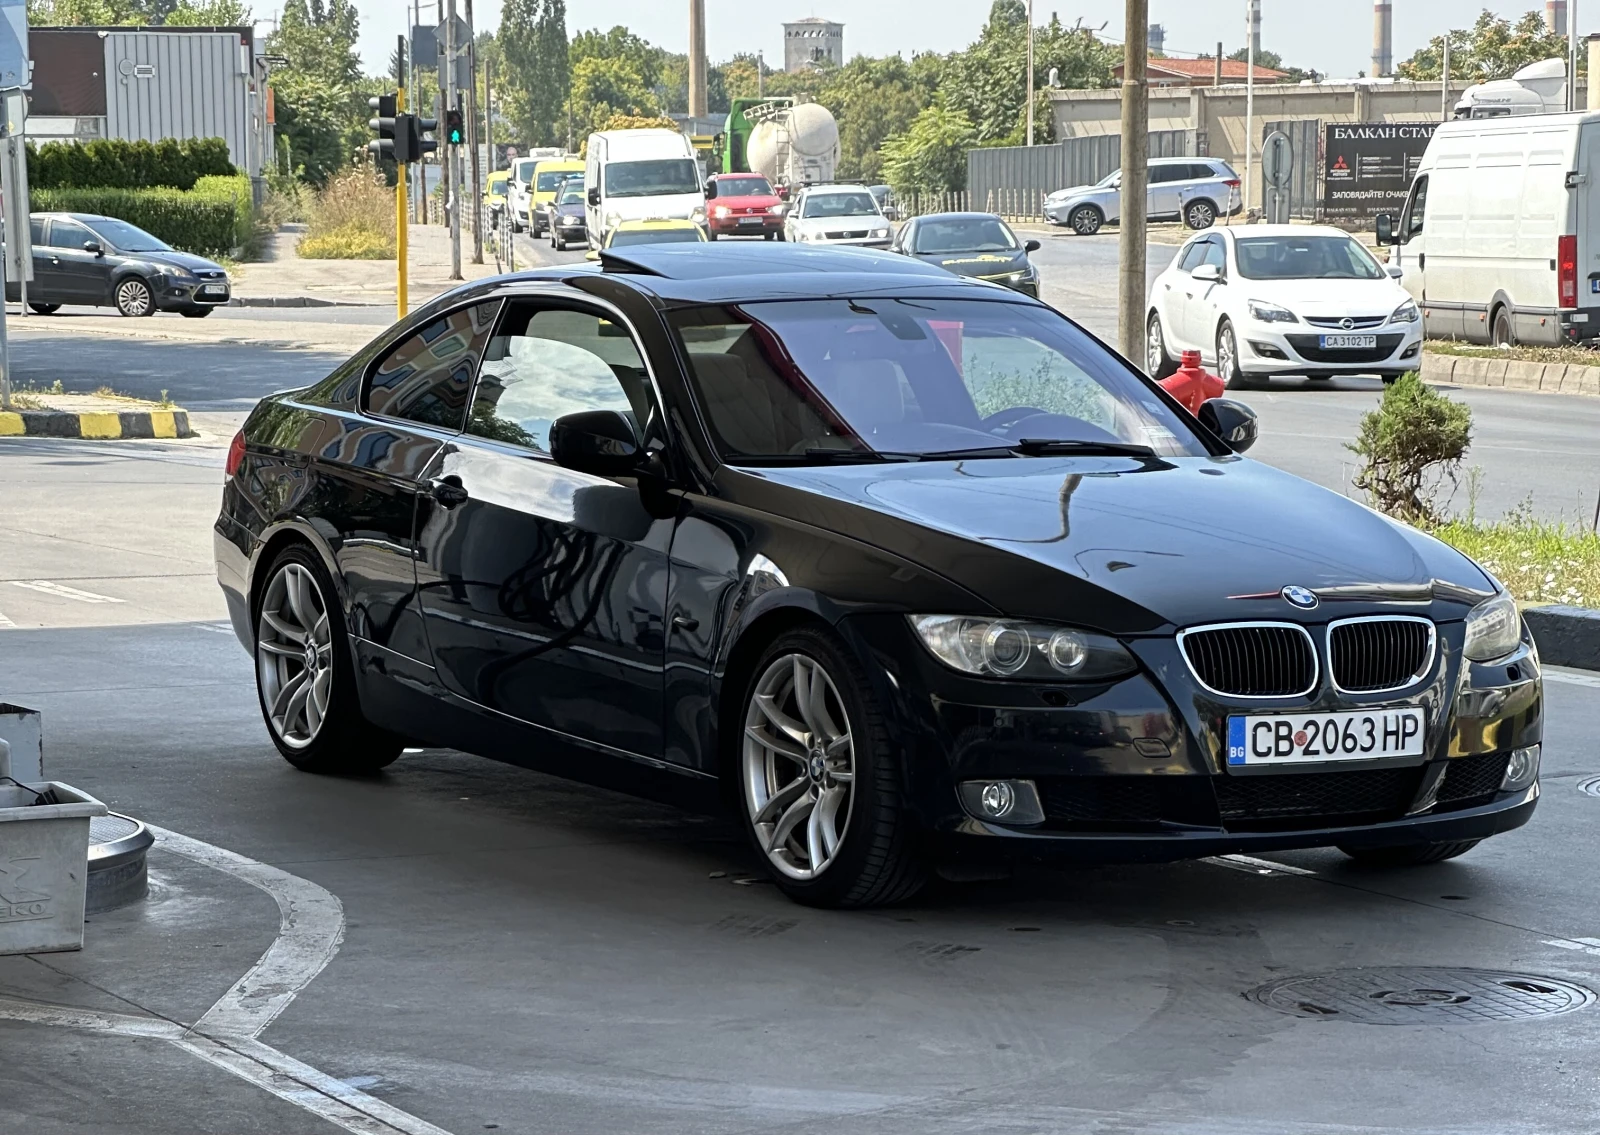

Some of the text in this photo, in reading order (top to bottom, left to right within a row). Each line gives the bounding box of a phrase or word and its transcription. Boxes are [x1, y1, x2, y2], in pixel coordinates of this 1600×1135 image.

[1335, 128, 1396, 139] БАЛКАН
[1340, 336, 1362, 347] 3102
[1252, 713, 1419, 758] CB 2063 HP
[1230, 746, 1245, 758] BG
